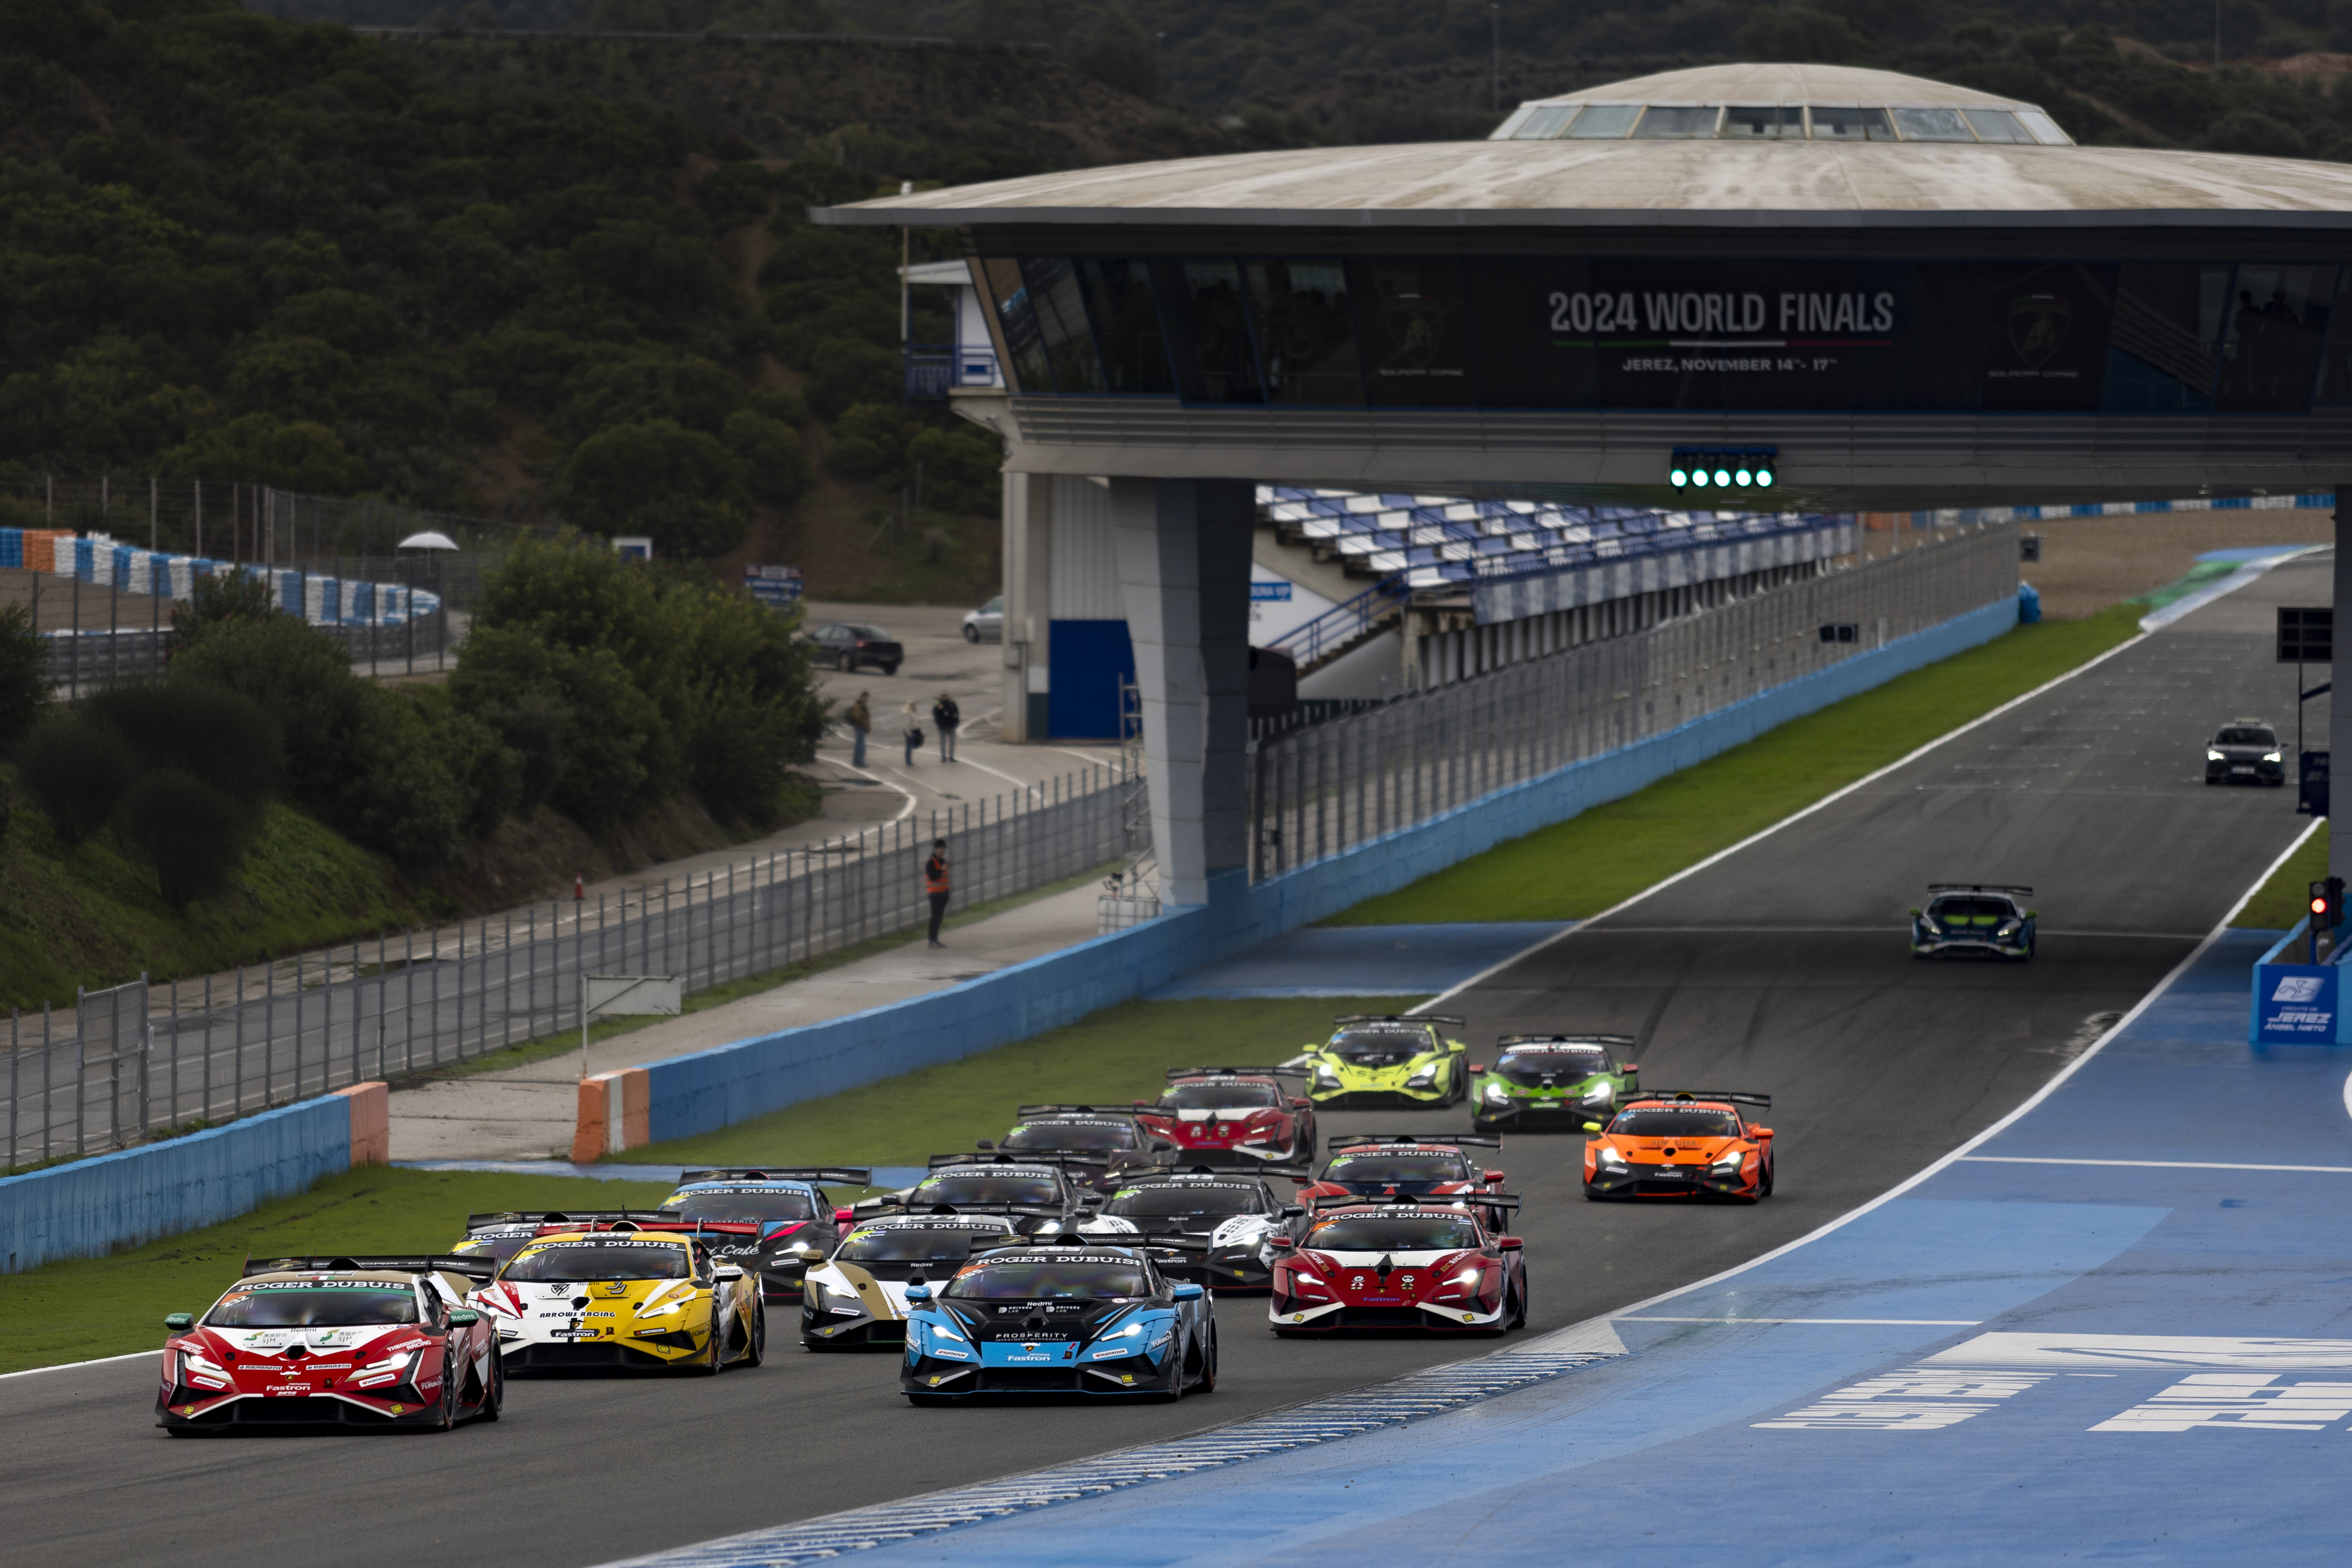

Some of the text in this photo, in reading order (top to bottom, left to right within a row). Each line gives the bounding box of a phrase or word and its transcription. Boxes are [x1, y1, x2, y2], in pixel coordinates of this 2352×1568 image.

[1549, 292, 1894, 332] 2024 WORLD FINALS
[1622, 359, 1678, 373] JEREZ,
[1681, 359, 1772, 371] NOVEMBER
[2267, 1011, 2332, 1024] JEREZ
[2297, 1024, 2327, 1032] NIETO
[1327, 1213, 1389, 1221] ROGER
[863, 1224, 925, 1232] ROGER
[1318, 1224, 1336, 1232] 211
[469, 1232, 532, 1240] ROGER
[851, 1234, 871, 1243] 277
[530, 1241, 596, 1250] ROGER
[722, 1244, 759, 1255] Café
[975, 1256, 1134, 1265] ROGER DUBUIS
[957, 1269, 984, 1280] 265
[237, 1281, 405, 1292] ROGER DUBUIS
[221, 1295, 250, 1307] 232
[386, 1338, 423, 1352] THEODORE
[407, 1340, 432, 1350] RACING
[1151, 1336, 1170, 1348] TURBO
[200, 1379, 224, 1388] HANKOOK
[367, 1375, 393, 1384] HANKOOK
[420, 1381, 440, 1391] TURBO
